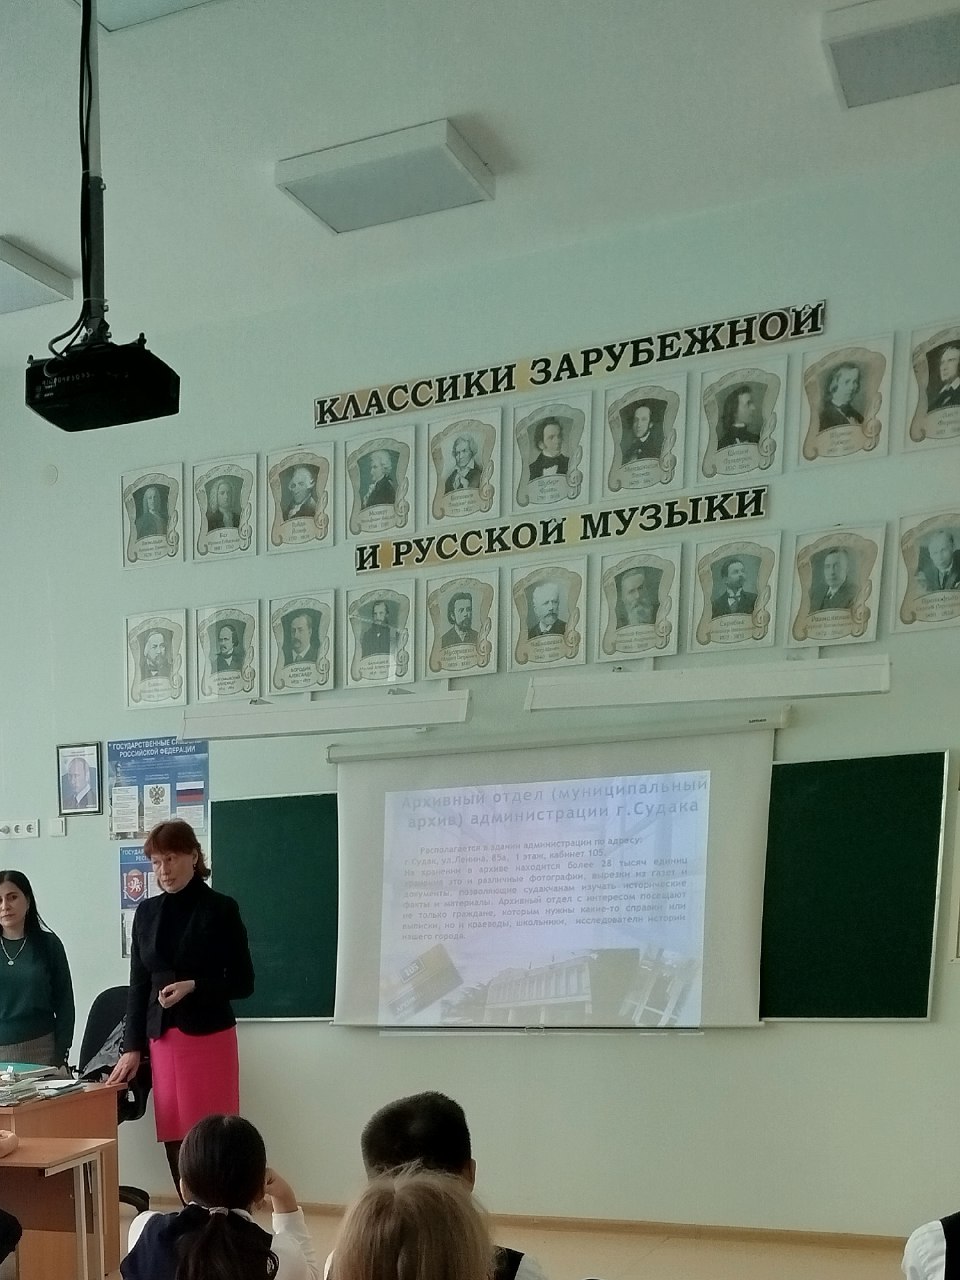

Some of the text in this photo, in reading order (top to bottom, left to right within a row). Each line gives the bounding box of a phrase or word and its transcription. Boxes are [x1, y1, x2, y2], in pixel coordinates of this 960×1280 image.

[316, 301, 826, 426] КЛАССИКИ ЗАРУБЕЖНОЙ
[356, 486, 766, 573] И РУССКОЙ МУЗЫКИ
[112, 739, 170, 751] ГОСУДАРСТВЕННЫЕ
[120, 745, 196, 758] РОССИЙСКОЙ ФЕДЕРАЦИИ
[402, 778, 707, 811] Архивный отдел (муниципальный
[408, 799, 699, 830] архив) администрации г.Судака
